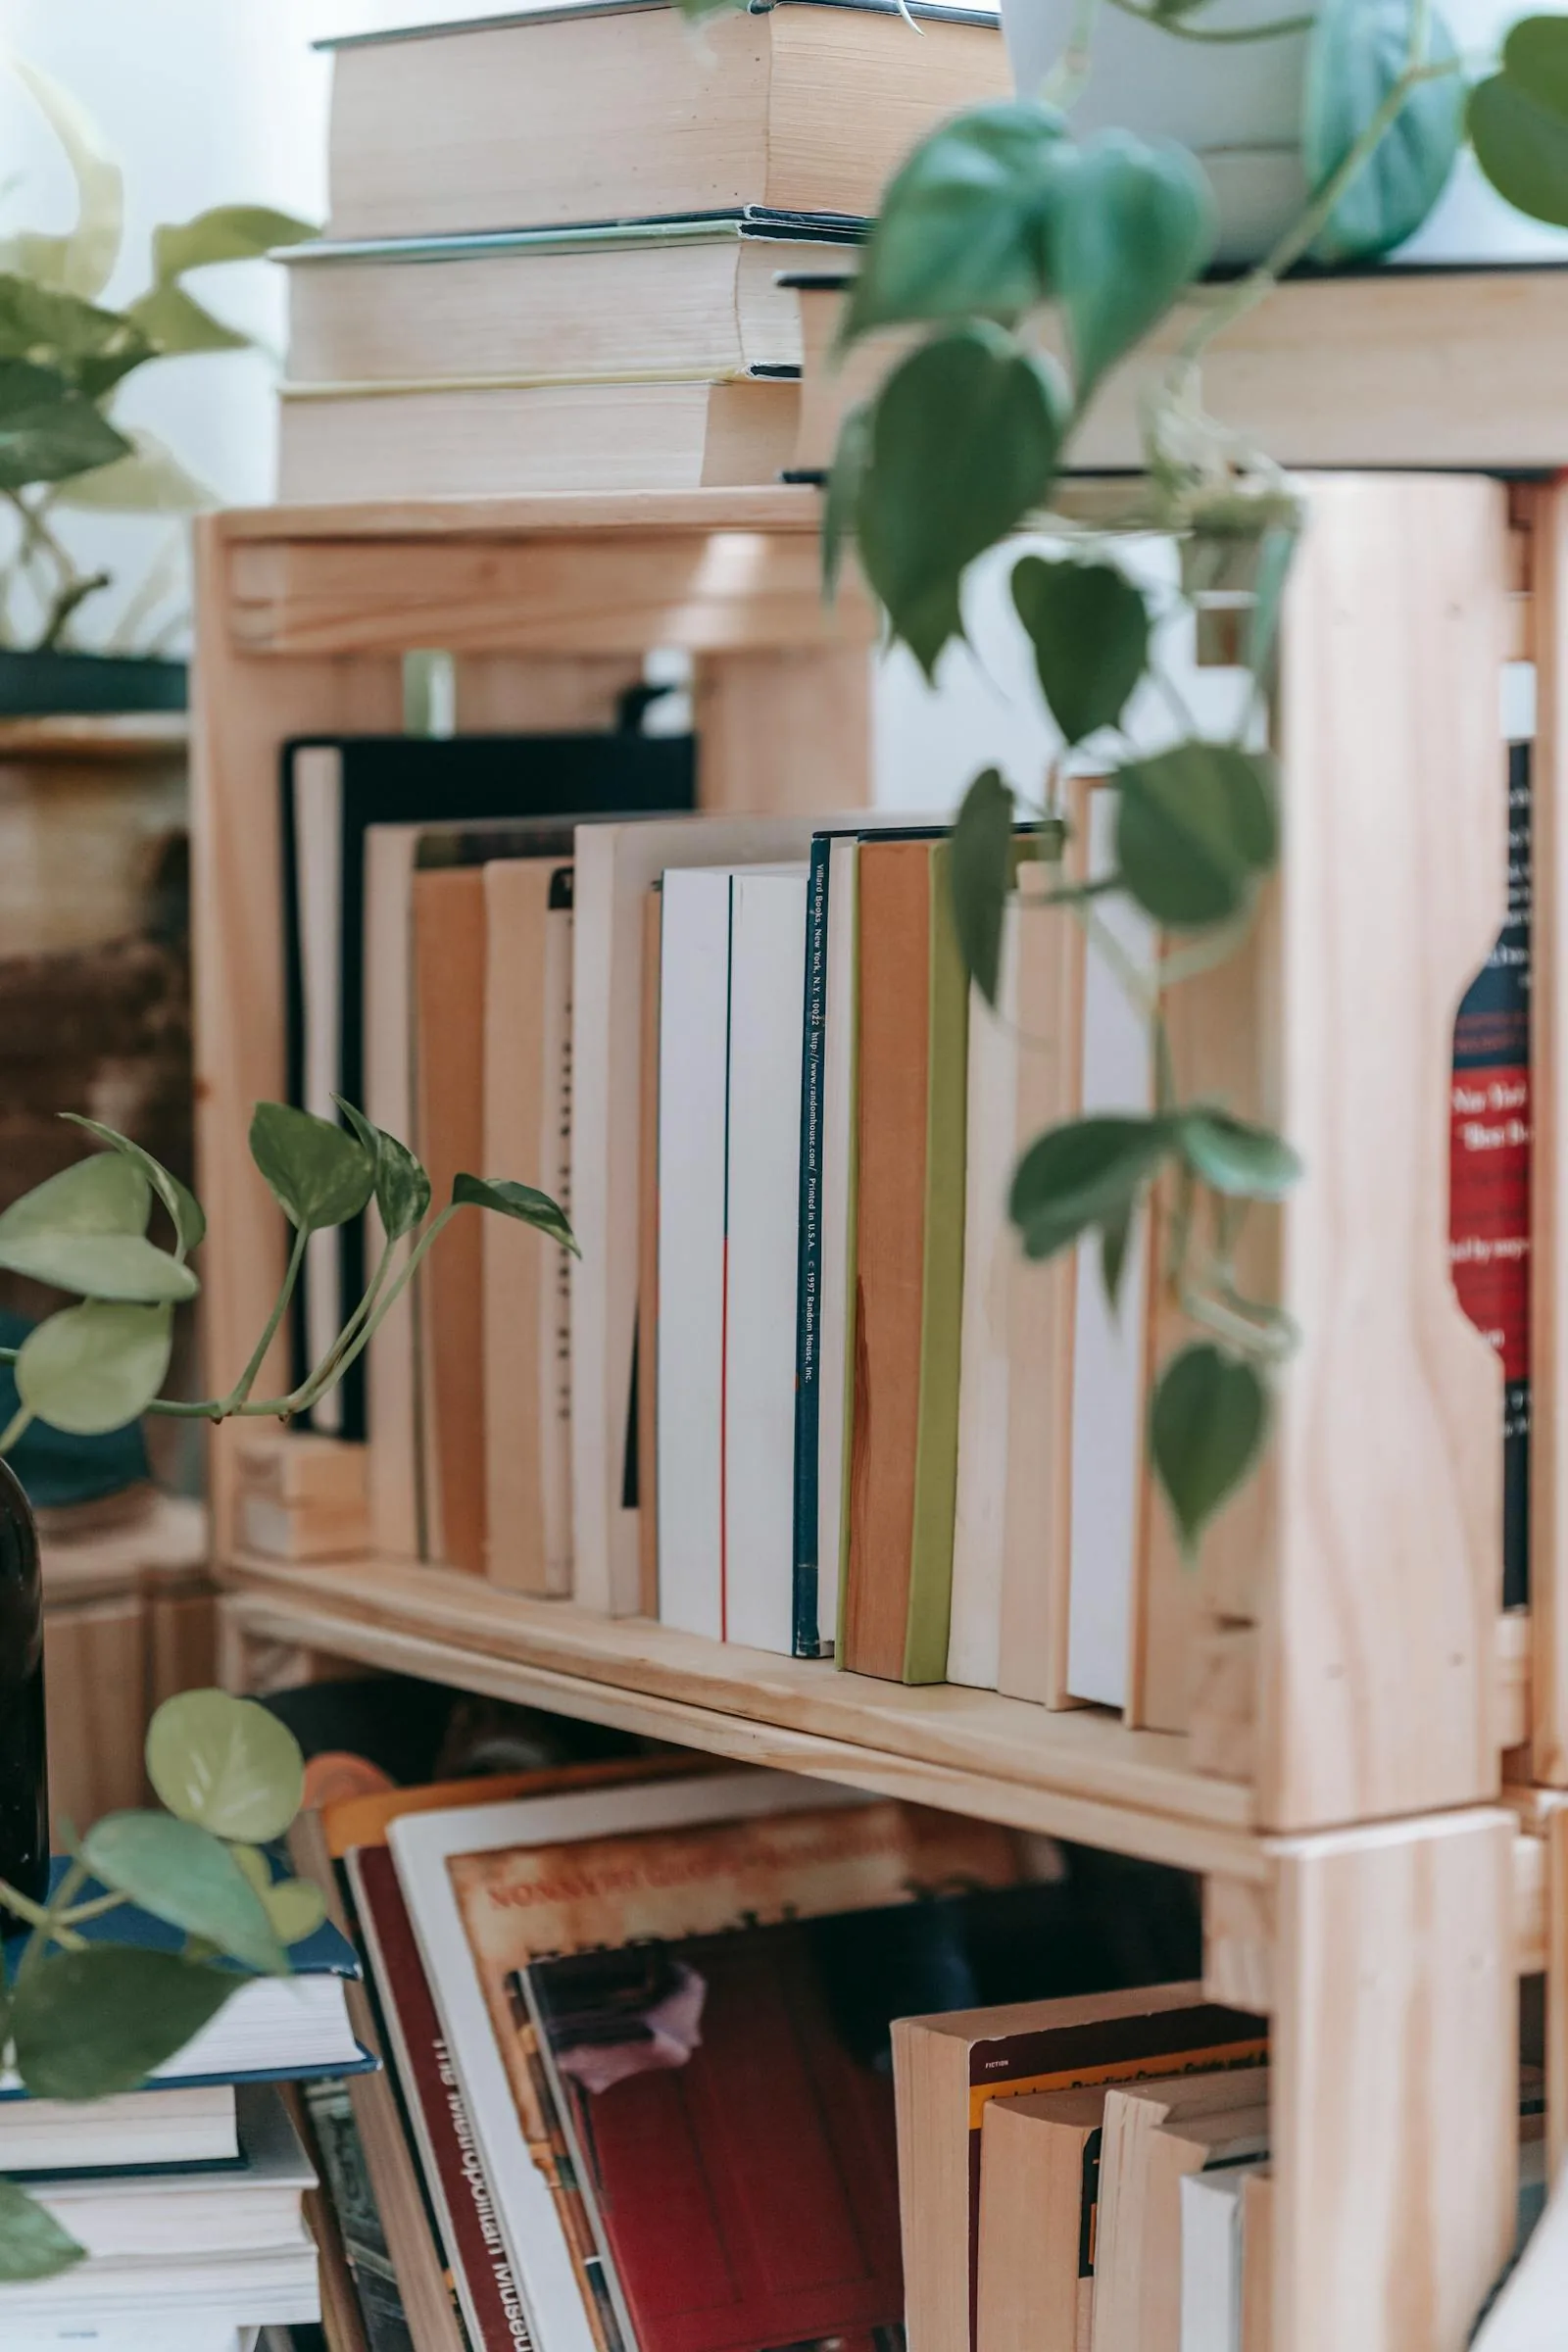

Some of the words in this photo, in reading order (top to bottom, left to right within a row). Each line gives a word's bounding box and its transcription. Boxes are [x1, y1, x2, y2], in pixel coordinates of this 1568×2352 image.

[815, 863, 824, 893] Villard
[813, 896, 823, 926] Books,
[812, 951, 821, 974] York,
[811, 976, 820, 995] N.Y.
[811, 999, 820, 1026] 10022
[808, 1032, 819, 1172] http://www.randomhouse.com/
[808, 1177, 816, 1210] Printed
[808, 1212, 815, 1221] in
[807, 1224, 815, 1251] U.S.A.
[807, 1272, 815, 1294] 1997
[806, 1296, 815, 1331] Random
[805, 1334, 814, 1364] House,
[985, 2060, 1009, 2070] FICTION
